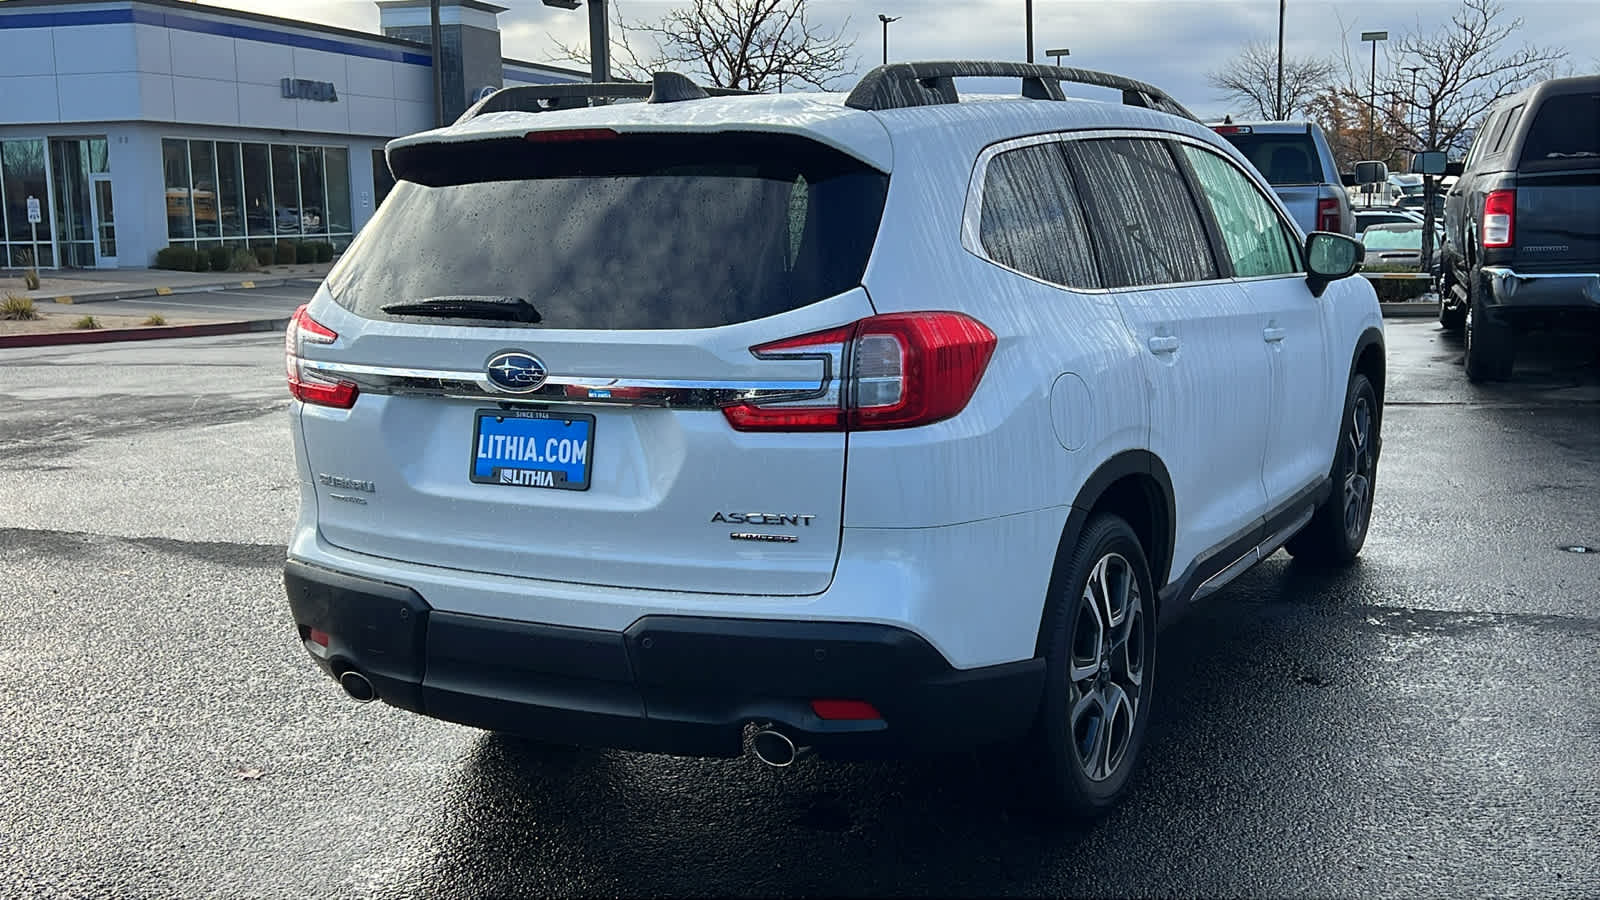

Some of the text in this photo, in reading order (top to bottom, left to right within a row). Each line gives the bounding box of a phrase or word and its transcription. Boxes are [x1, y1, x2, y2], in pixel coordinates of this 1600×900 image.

[280, 78, 338, 102] LITHIA
[515, 411, 534, 419] SINCE
[477, 433, 588, 465] LITHIA.COM
[319, 472, 376, 493] SUBARU
[512, 469, 555, 487] LITHIA
[711, 511, 817, 526] ASCENT
